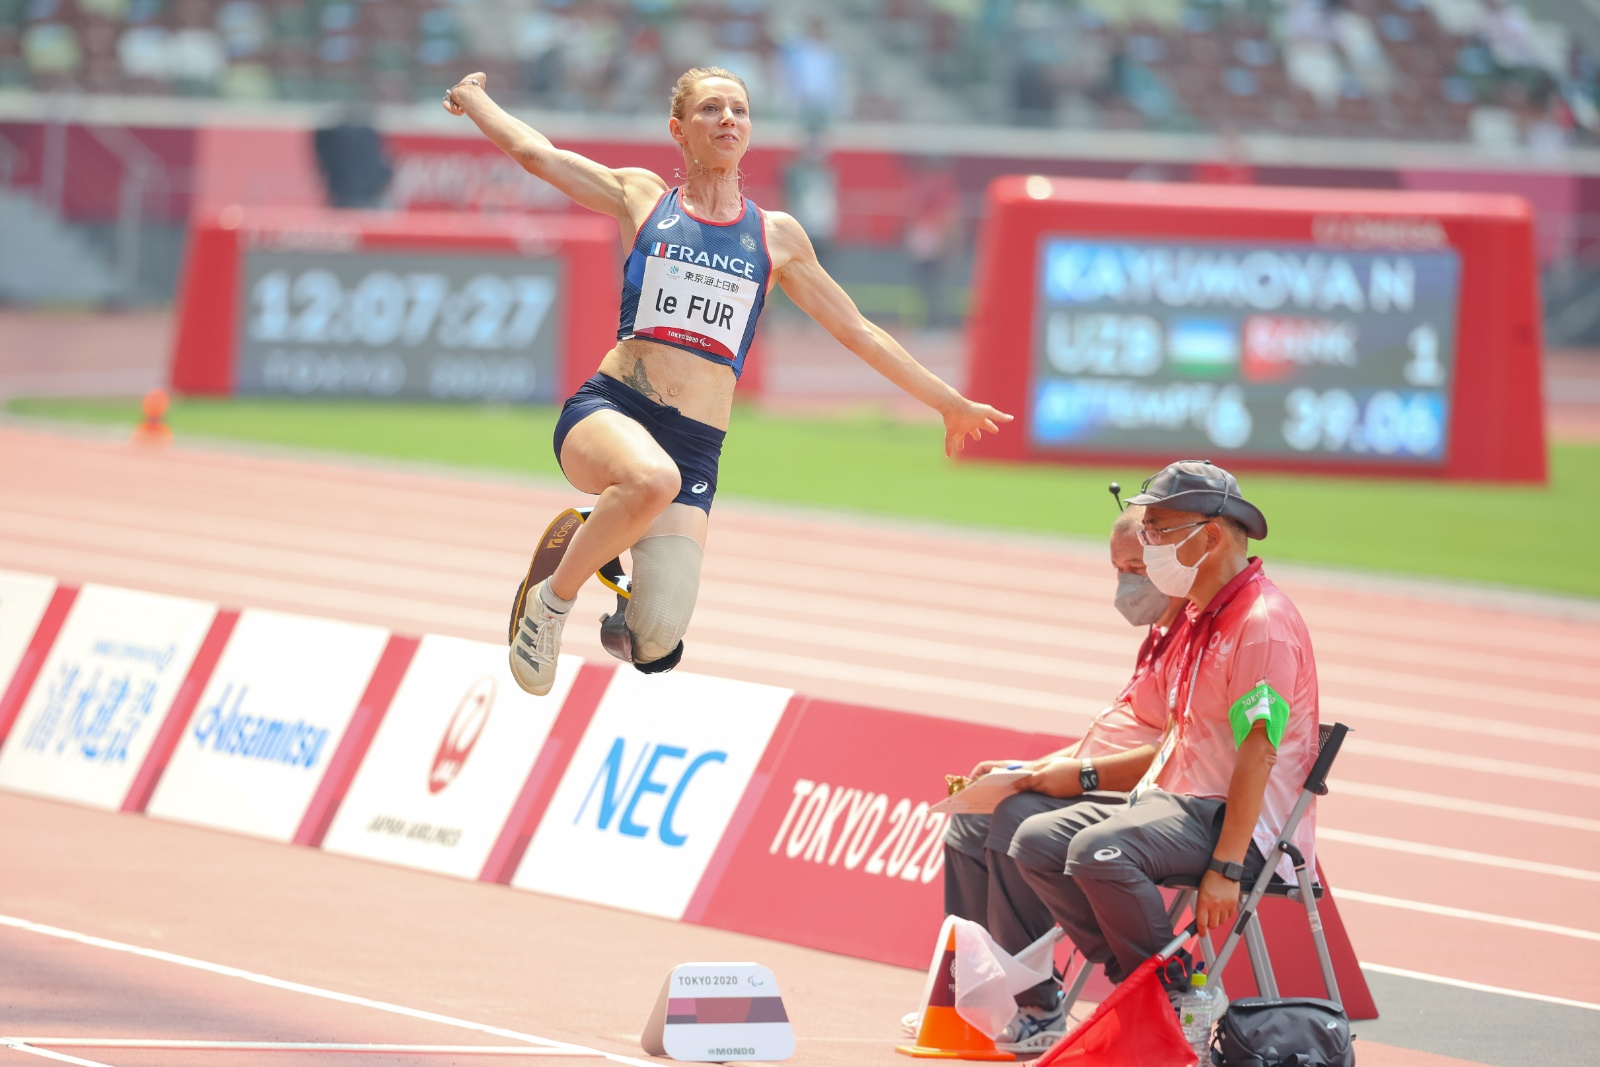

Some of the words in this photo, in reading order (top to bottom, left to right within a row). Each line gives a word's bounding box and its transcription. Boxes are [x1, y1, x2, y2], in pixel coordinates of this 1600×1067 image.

[666, 244, 754, 279] FRANCE
[684, 271, 739, 293] 東京海上日動
[252, 268, 557, 348] 12:07:27
[655, 288, 677, 314] le
[687, 295, 734, 330] FUR
[1046, 312, 1163, 376] UZB
[1404, 323, 1447, 387] 1
[573, 736, 729, 848] NEC
[769, 778, 888, 870] TOKYO
[678, 976, 711, 986] TOKYO
[714, 976, 738, 985] 2020
[715, 1047, 756, 1056] MONDO
